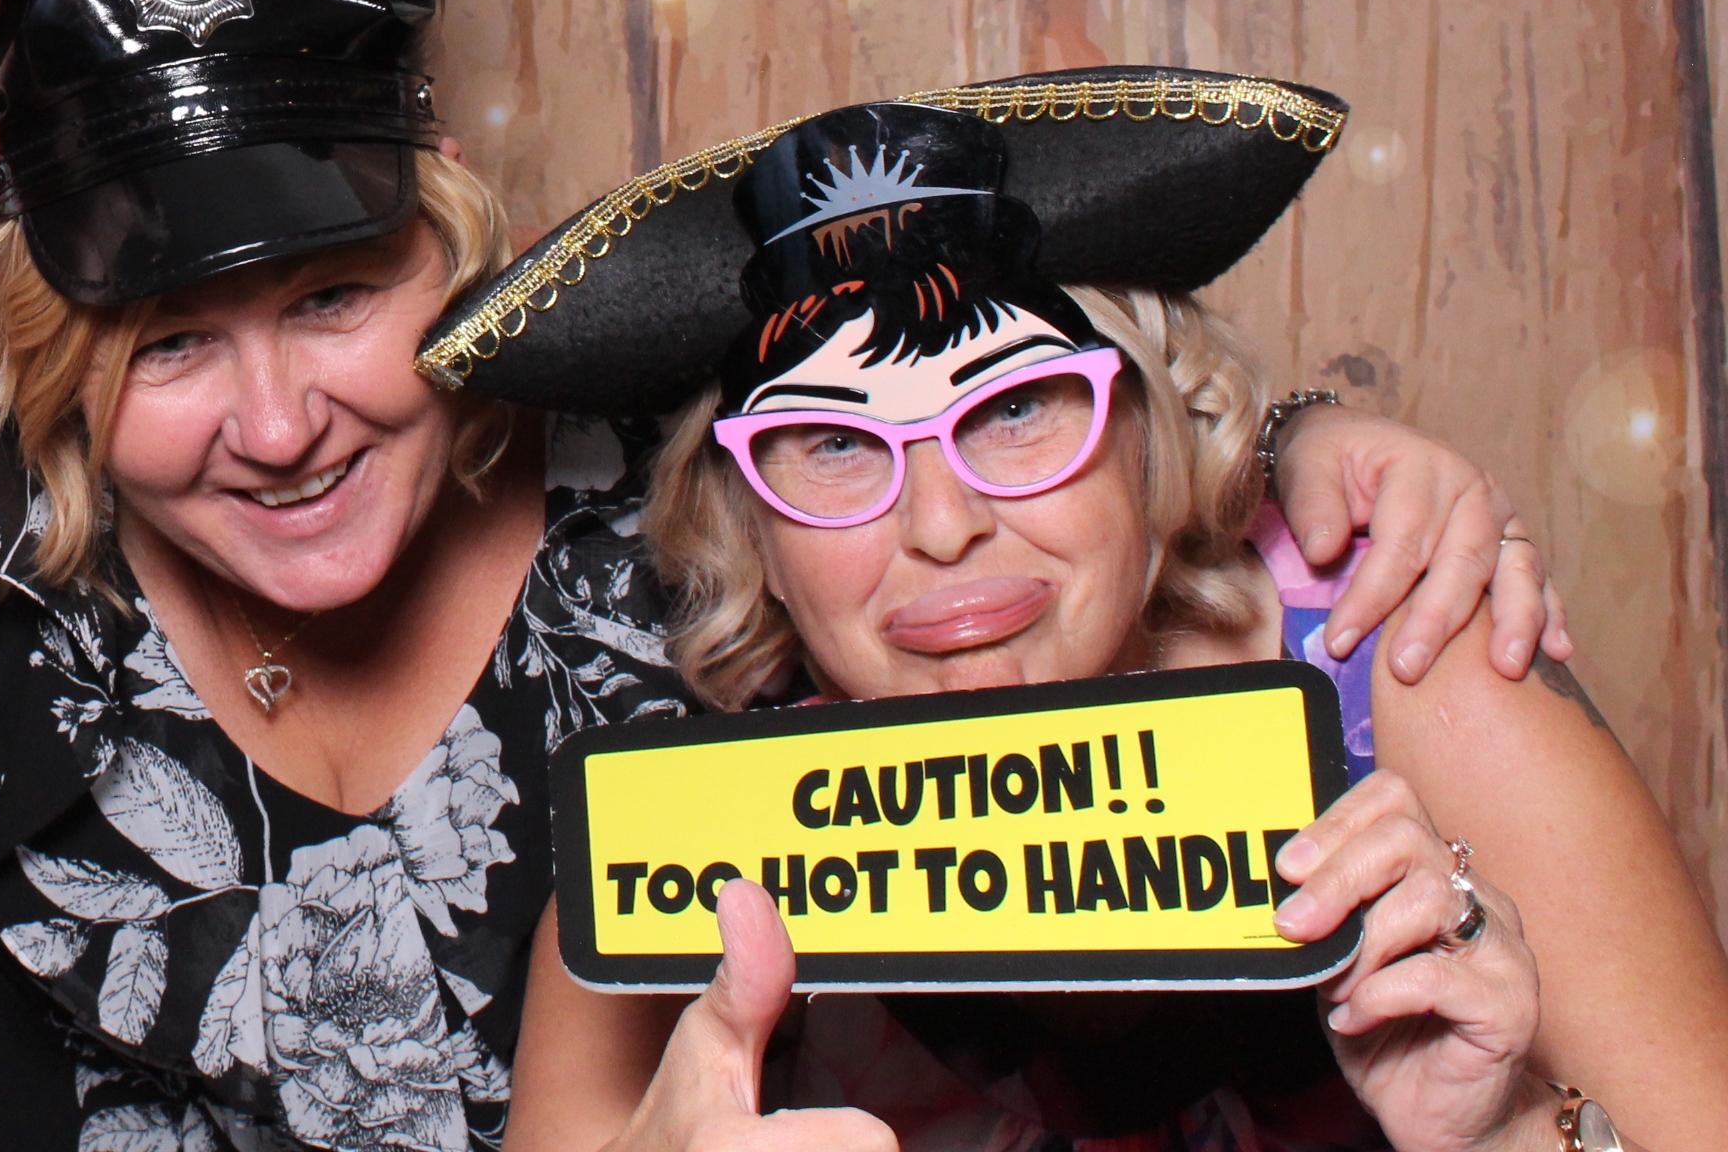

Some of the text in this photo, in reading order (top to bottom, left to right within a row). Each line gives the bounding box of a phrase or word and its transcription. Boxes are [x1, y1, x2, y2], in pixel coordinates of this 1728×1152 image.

[792, 729, 1165, 829] CAUTION!!
[761, 849, 899, 916] HOT
[915, 846, 1008, 913] TO
